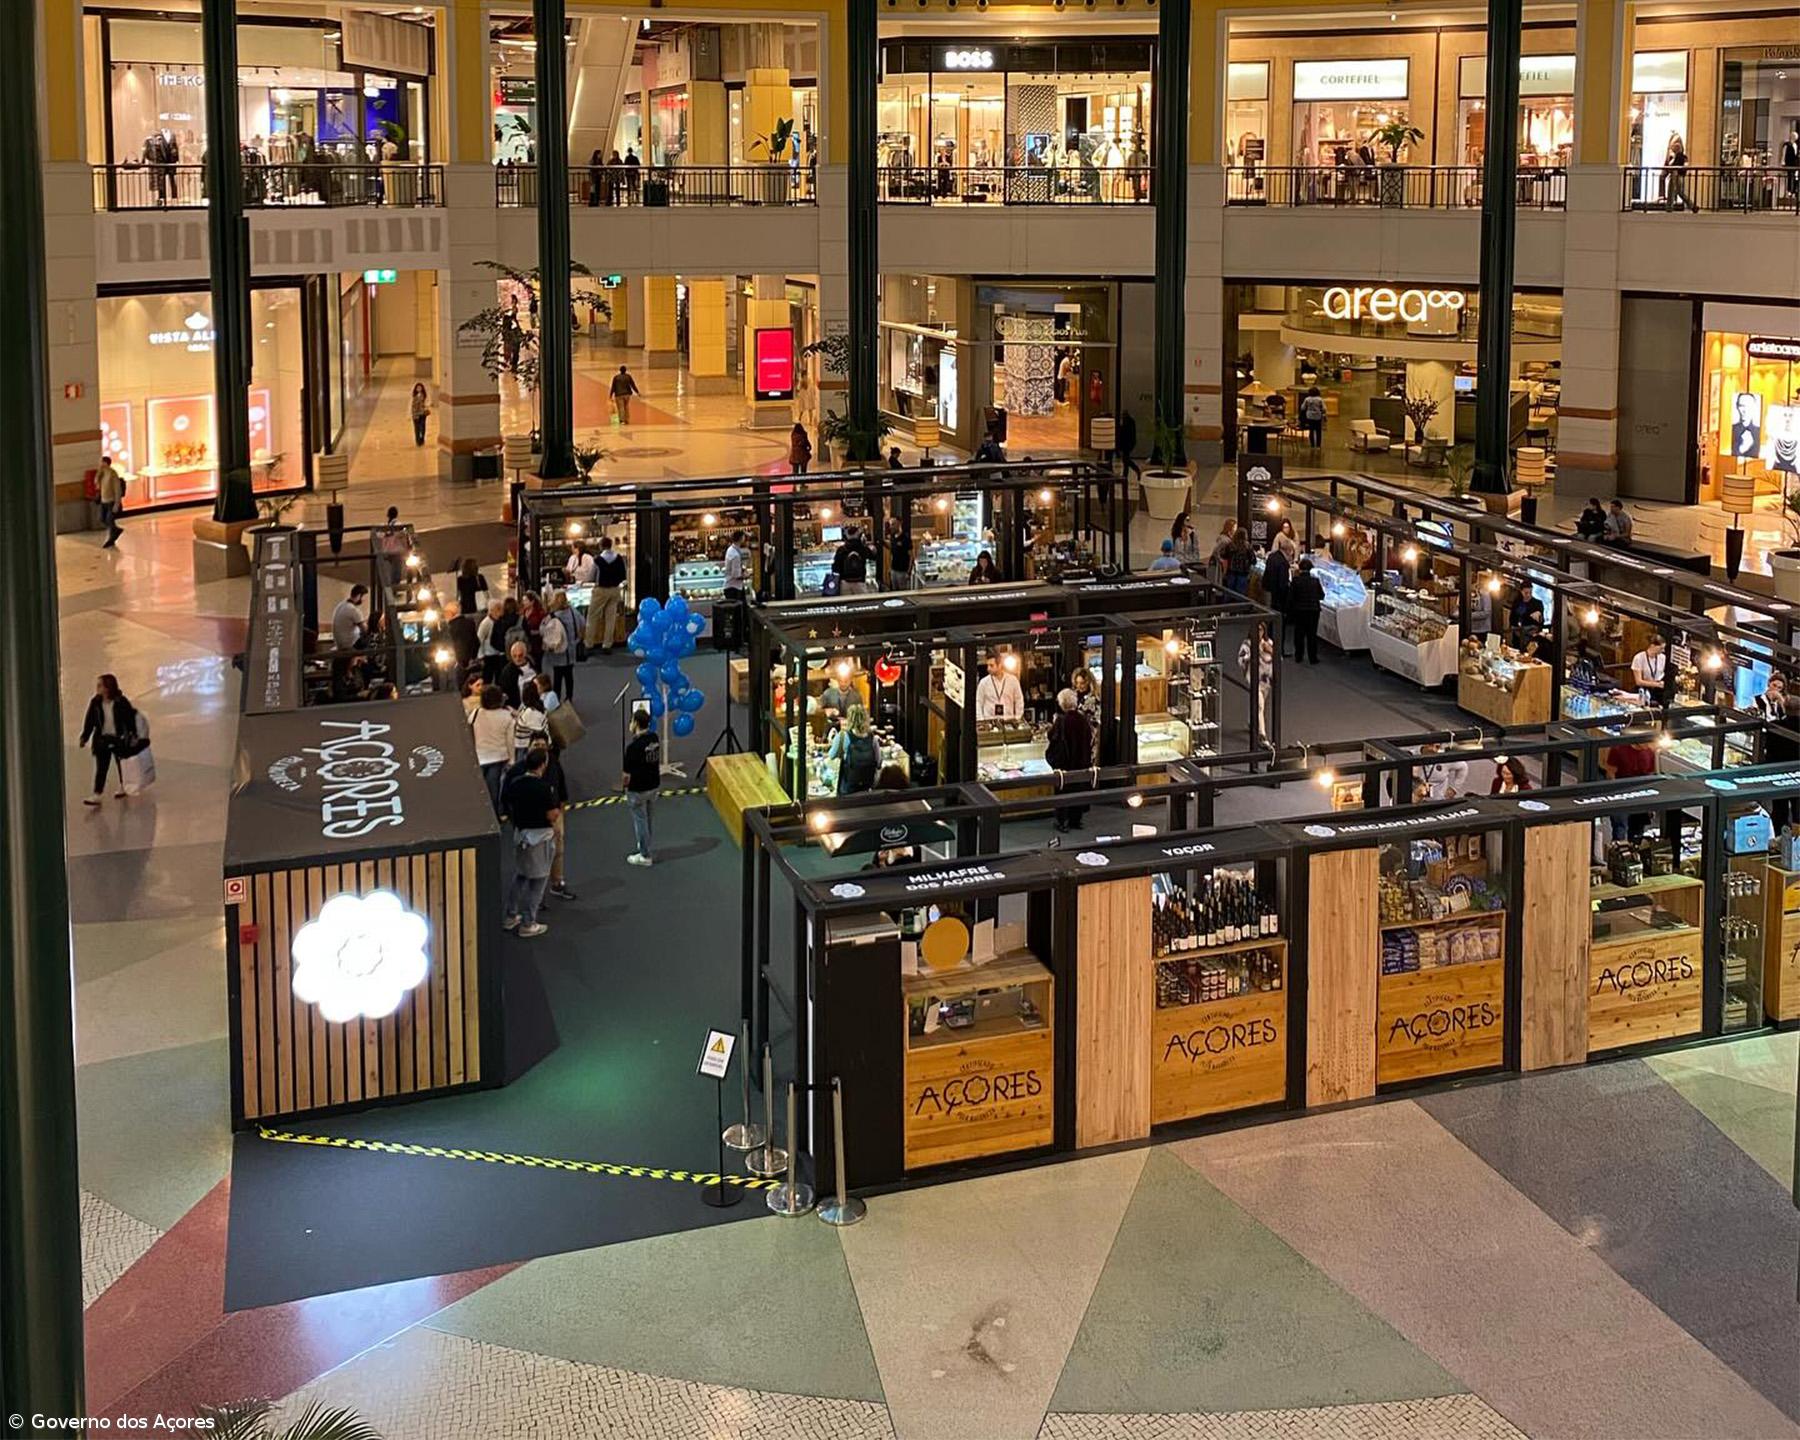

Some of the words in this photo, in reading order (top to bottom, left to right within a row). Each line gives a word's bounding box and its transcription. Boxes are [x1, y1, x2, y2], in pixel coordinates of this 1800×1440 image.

[945, 51, 993, 68] BOSS
[1320, 74, 1380, 84] CORTEFIEL
[302, 720, 405, 838] AÇORES
[1338, 819, 1407, 833] MERCADO
[1407, 816, 1437, 826] DAS
[1437, 808, 1480, 821] ILHAS
[1162, 843, 1215, 857] YOÇOR
[905, 881, 940, 891] DOS
[943, 872, 1006, 887] AÇORES
[908, 865, 990, 884] MILHAFRE
[1596, 956, 1693, 996] AÇORES
[1388, 1002, 1495, 1045] AÇORES
[1163, 1018, 1277, 1064] AÇORES
[915, 1069, 1042, 1116] AÇORES
